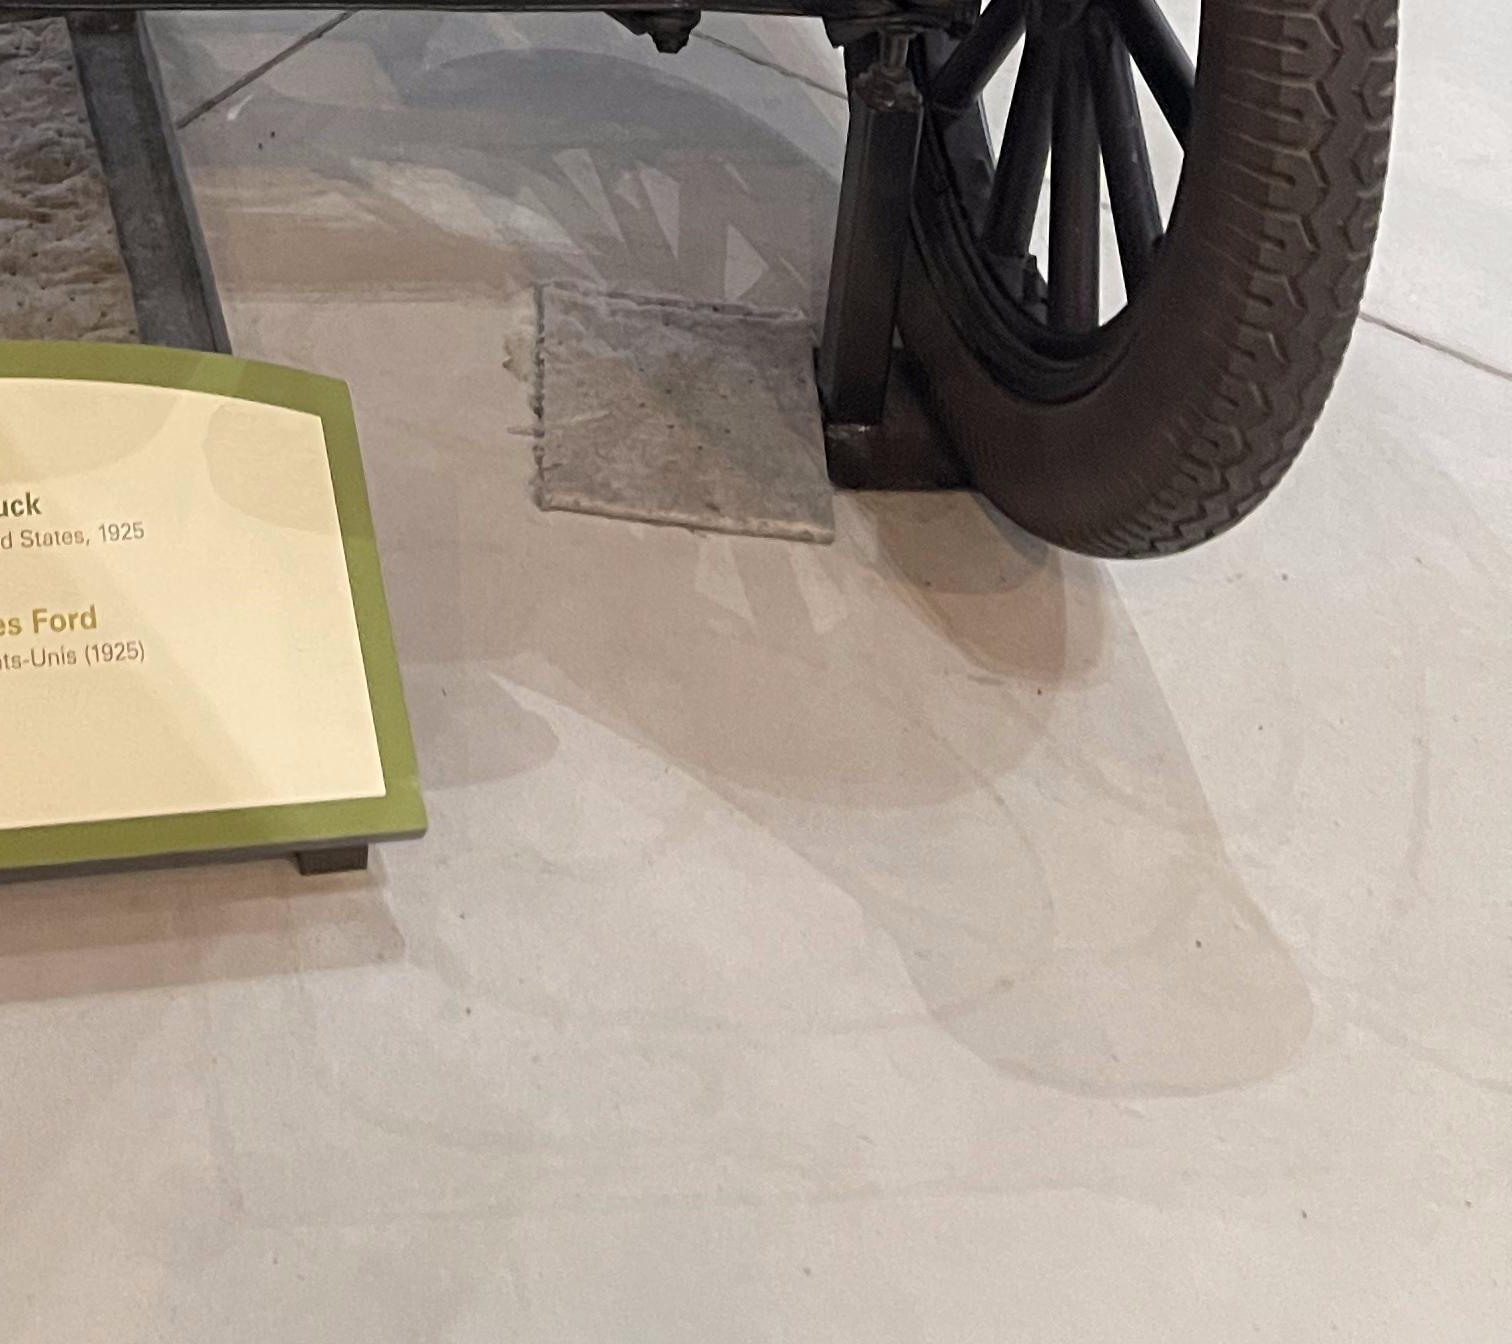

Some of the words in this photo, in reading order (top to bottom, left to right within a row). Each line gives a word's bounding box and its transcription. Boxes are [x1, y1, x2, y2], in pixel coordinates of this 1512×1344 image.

[20, 528, 91, 549] States,
[98, 521, 145, 543] 1925
[32, 604, 98, 635] Ford
[84, 640, 146, 667] (1925)
